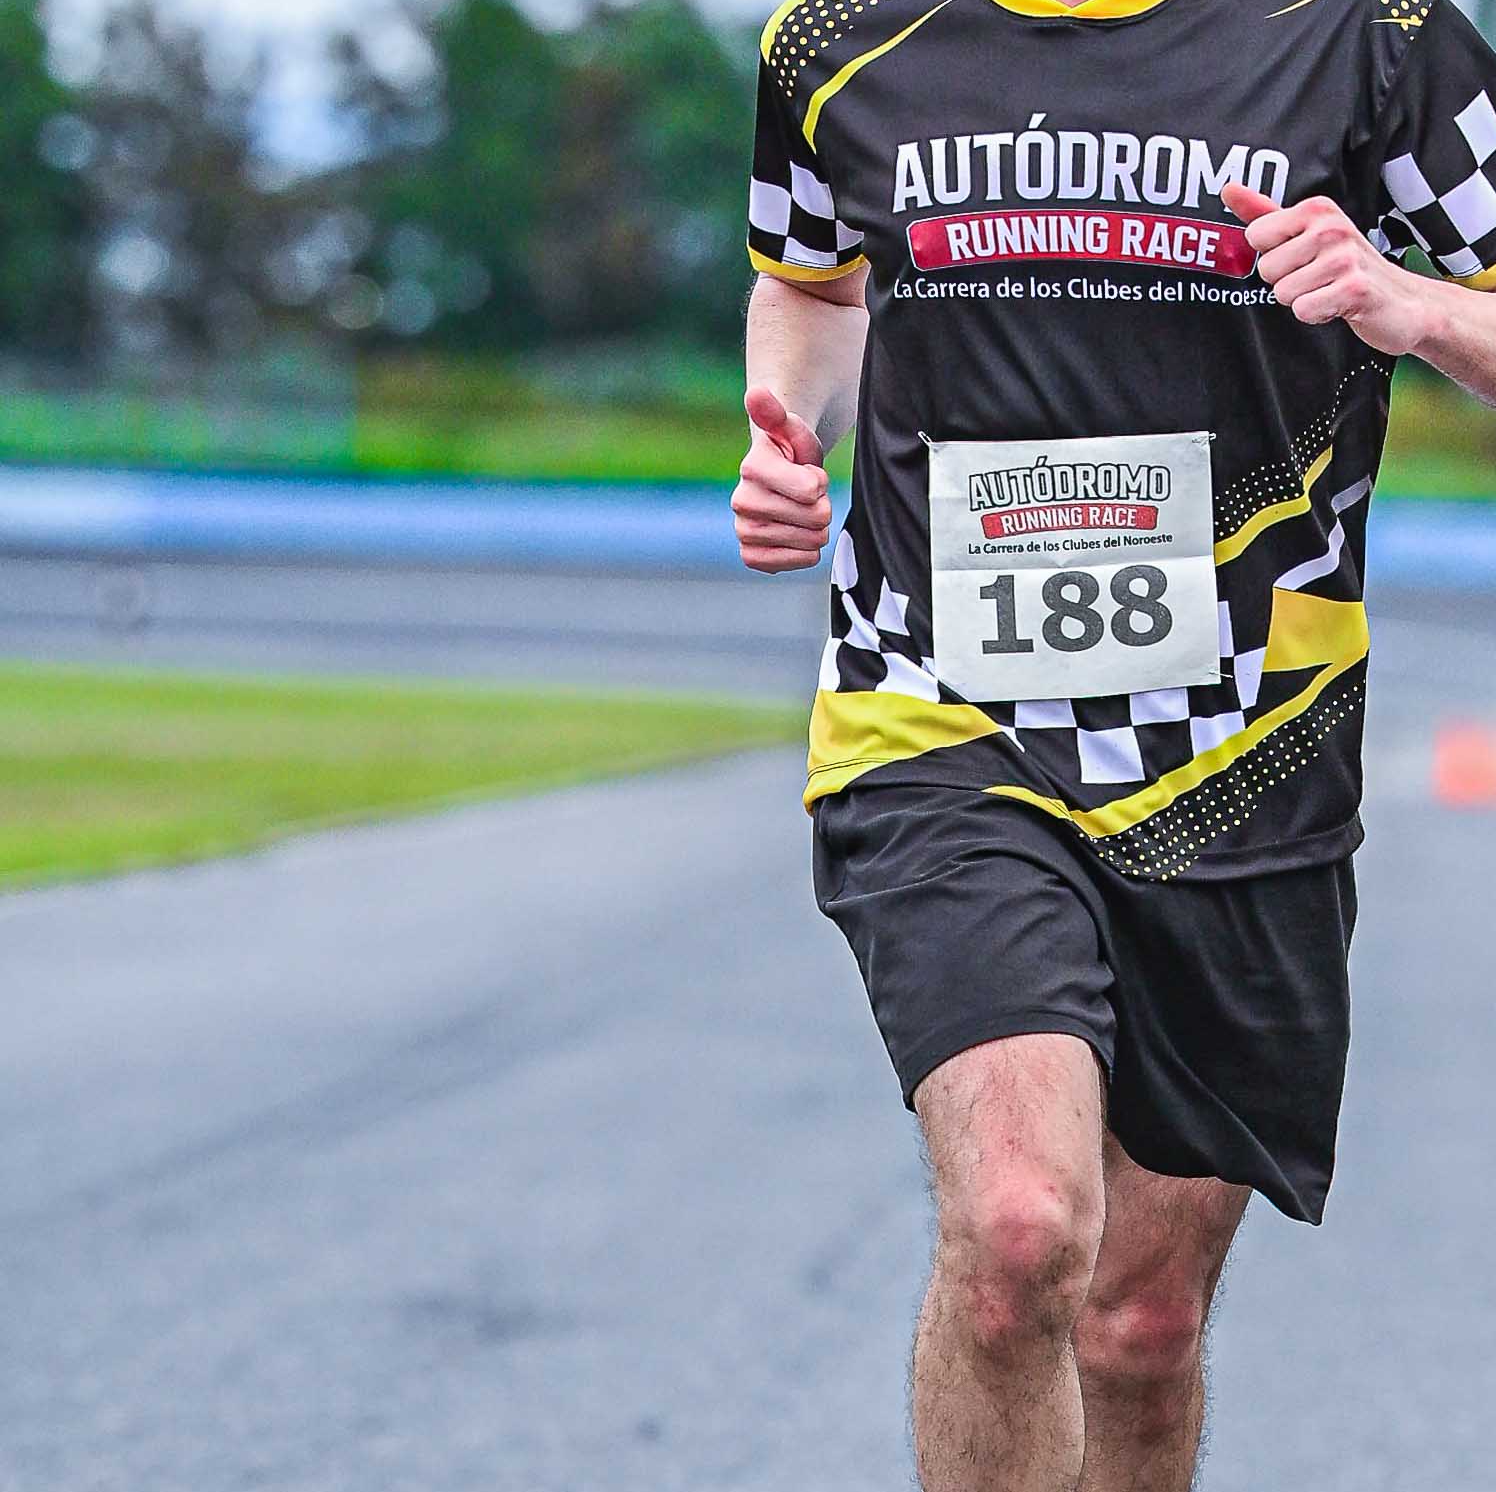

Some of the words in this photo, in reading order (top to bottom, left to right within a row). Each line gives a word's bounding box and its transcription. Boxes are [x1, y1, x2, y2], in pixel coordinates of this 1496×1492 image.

[893, 113, 1290, 213] AUTÓDROMO
[944, 216, 1110, 262] RUNNING
[1121, 219, 1221, 268] RACE
[893, 277, 913, 299] La
[914, 277, 991, 299] Carrera
[996, 277, 1025, 299] de
[1030, 277, 1062, 299] los
[1067, 276, 1143, 301] Clubes
[1149, 280, 1184, 302] del
[1190, 282, 1277, 307] Noroeste
[969, 455, 1171, 512] AUTÓDROMO
[968, 542, 982, 556] La
[983, 541, 1025, 554] Carrera
[1026, 539, 1042, 553] de
[1043, 539, 1060, 552] los
[1062, 537, 1101, 552] Clubes
[1103, 535, 1122, 548] del
[1123, 533, 1173, 548] Noroeste
[1000, 506, 1083, 535] RUNNING
[1088, 506, 1137, 528] RACE
[979, 564, 1173, 655] 188
